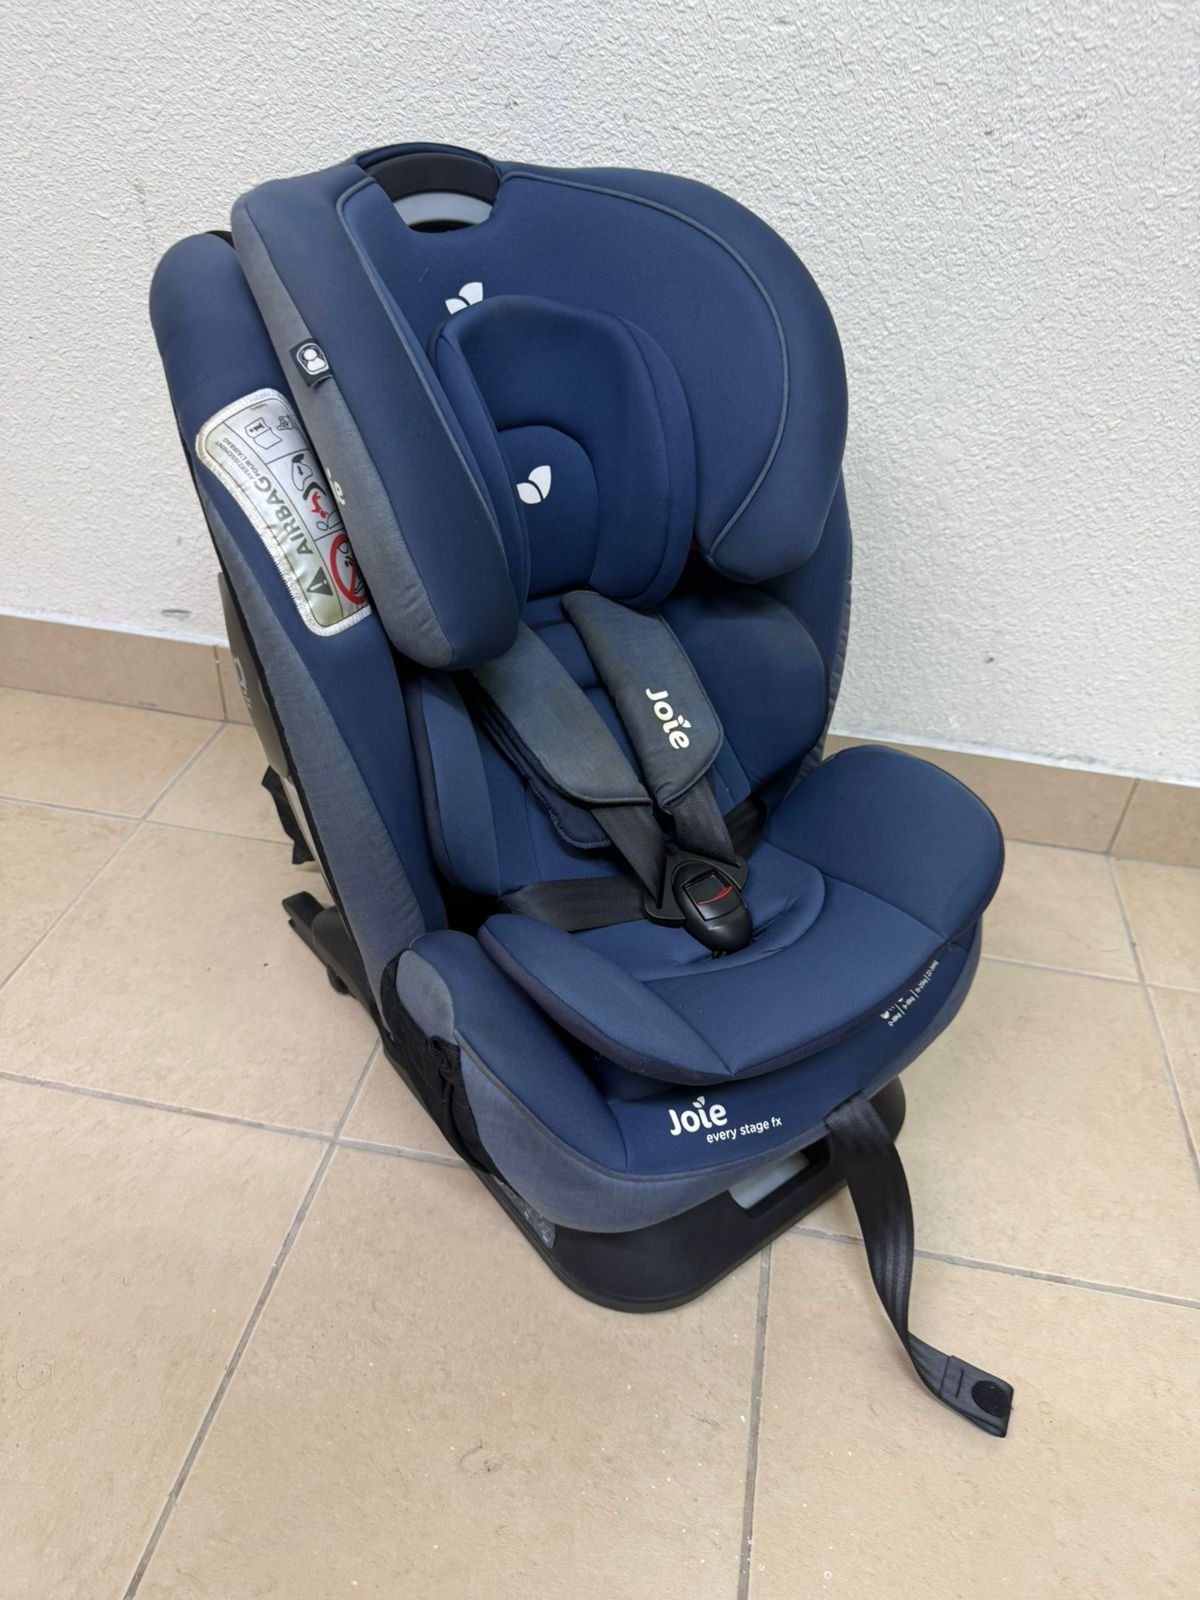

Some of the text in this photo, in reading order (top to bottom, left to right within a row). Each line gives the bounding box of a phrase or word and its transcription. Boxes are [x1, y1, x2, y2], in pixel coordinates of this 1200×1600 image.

[215, 441, 255, 480] AVERTISSEMENT
[245, 460, 261, 477] POUR
[253, 475, 314, 556] AIRBAG
[645, 688, 691, 750] Joie
[668, 1095, 728, 1136] Joie
[706, 1116, 782, 1143] every stage fx
